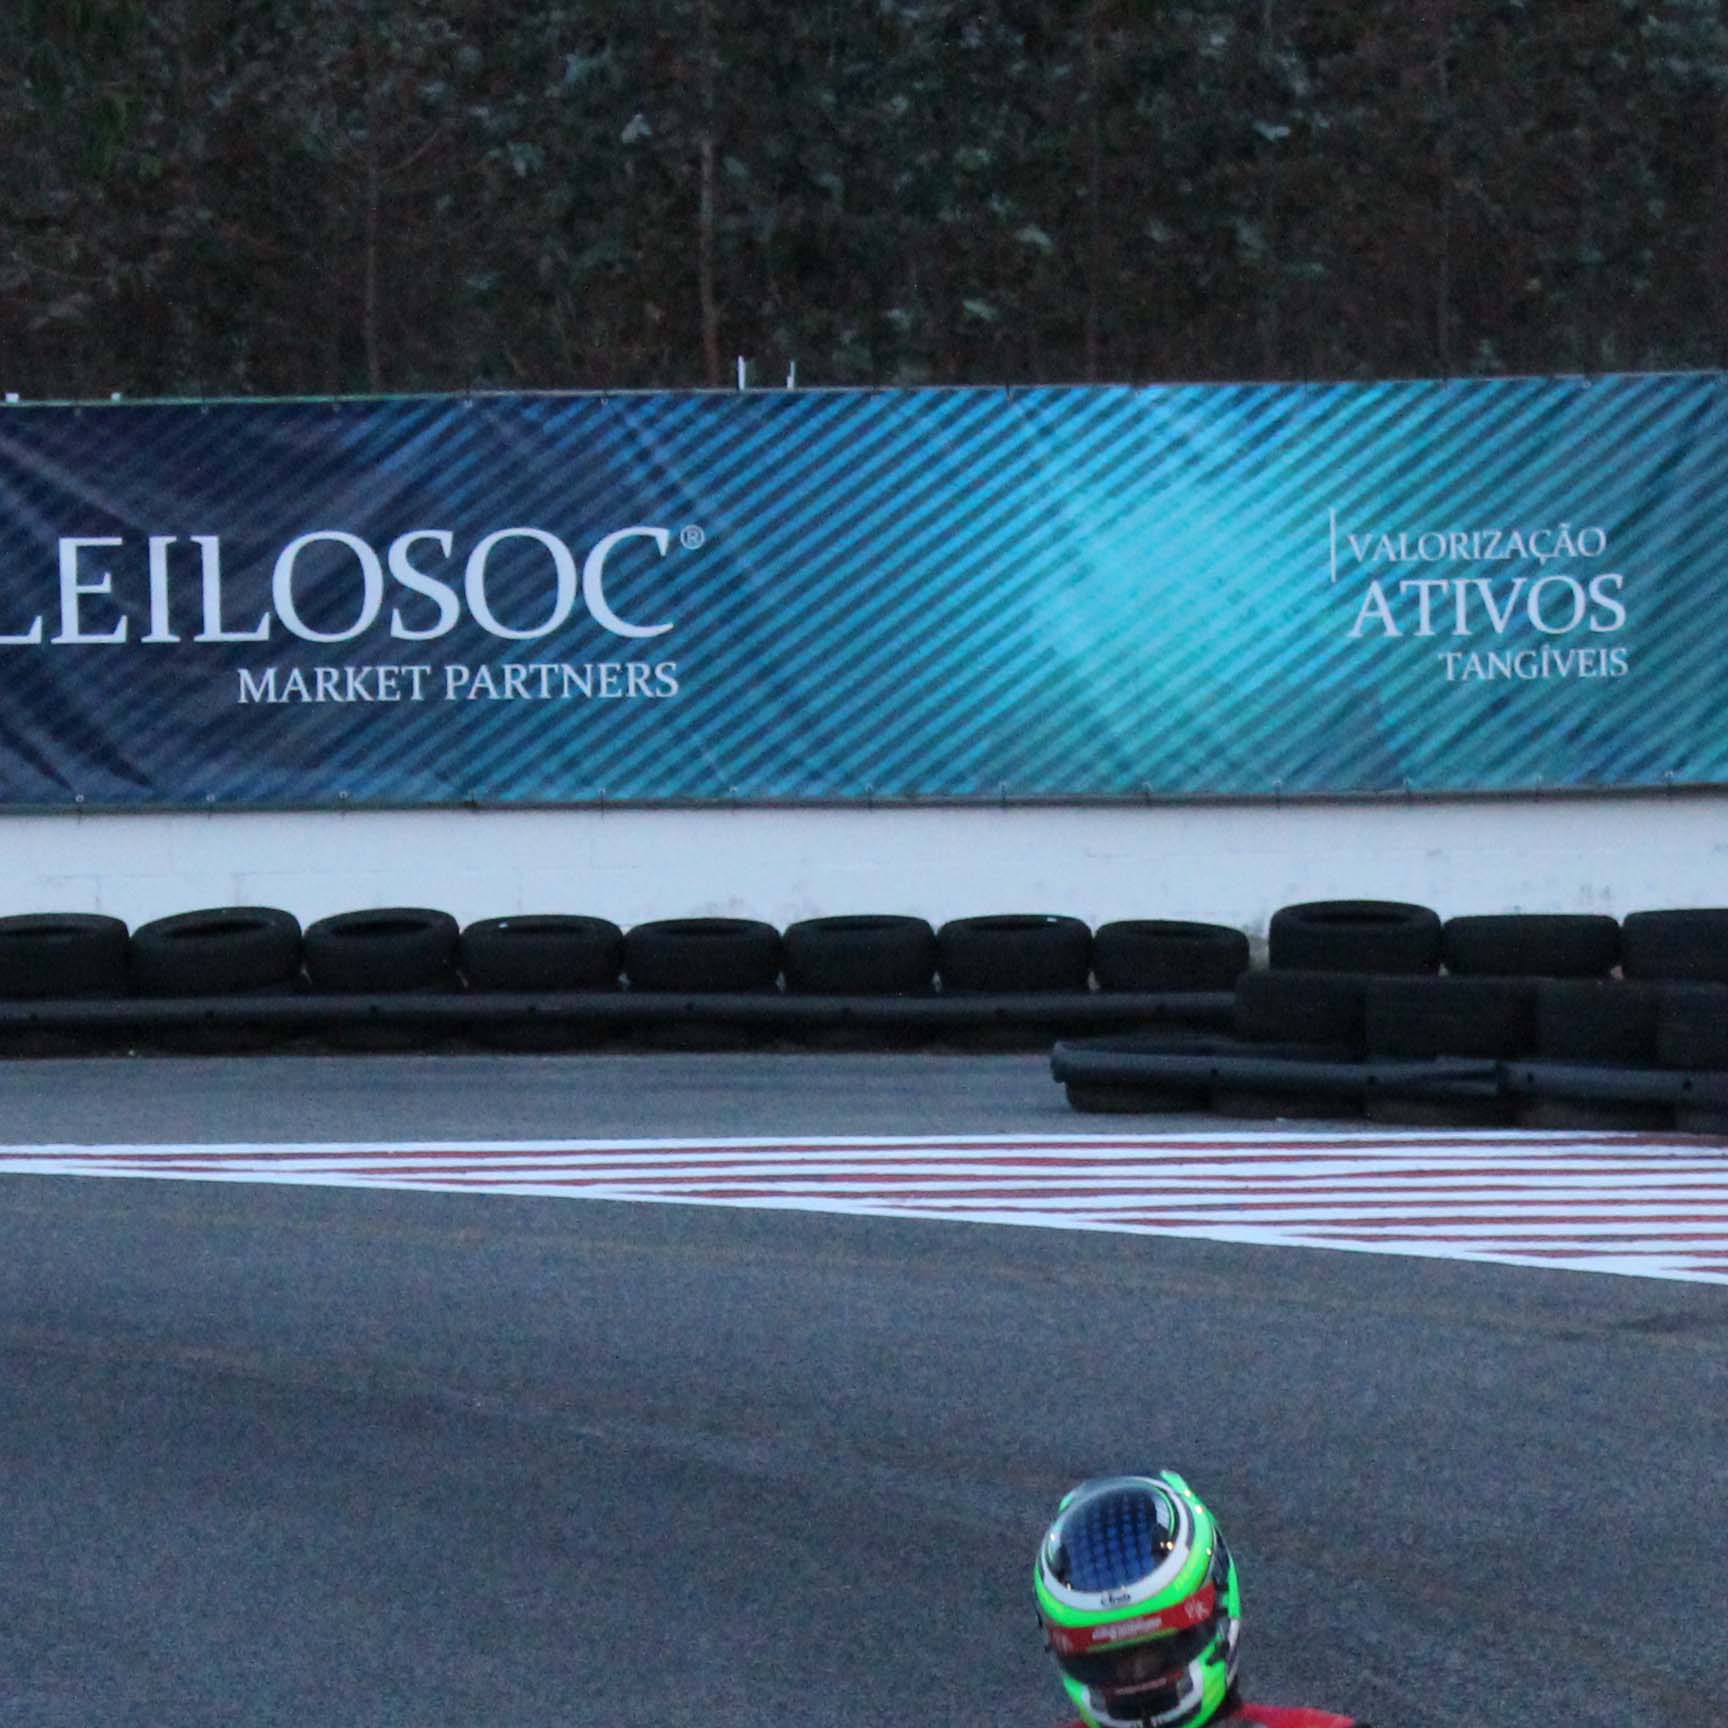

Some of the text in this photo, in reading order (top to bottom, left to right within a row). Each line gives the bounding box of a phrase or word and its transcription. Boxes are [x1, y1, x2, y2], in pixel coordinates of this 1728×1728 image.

[1347, 521, 1608, 566] VALORIZAÇÃO
[1348, 572, 1628, 639] ATIVOS
[236, 661, 680, 704] MARKET PARTNERS
[1437, 644, 1629, 682] TANGÍVEIS
